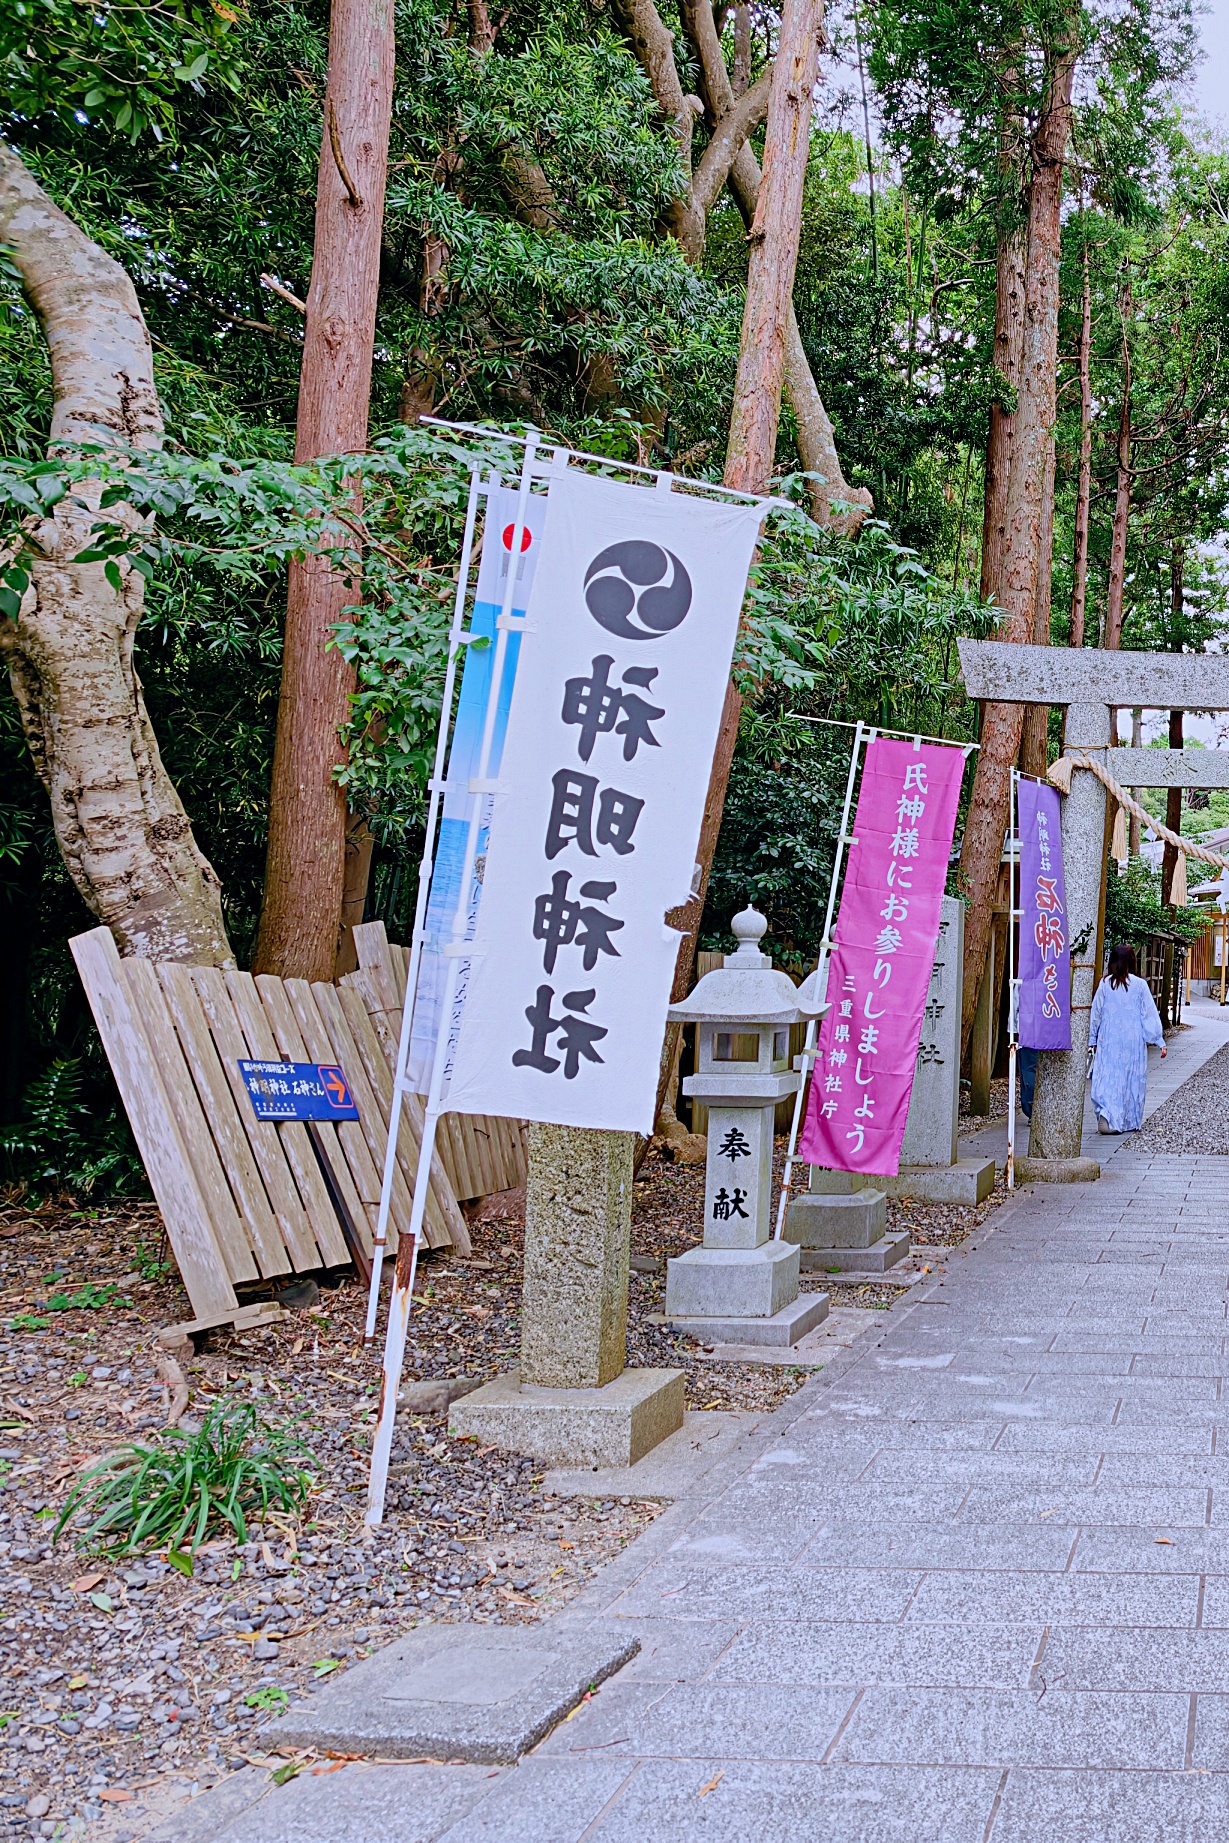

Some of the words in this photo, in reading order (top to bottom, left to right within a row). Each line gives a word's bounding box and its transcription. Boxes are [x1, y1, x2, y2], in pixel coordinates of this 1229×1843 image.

[846, 762, 929, 1155] 氏神様にお参りしましょう
[820, 975, 857, 1120] 三重県神社庁
[713, 1127, 752, 1221] 奉献
